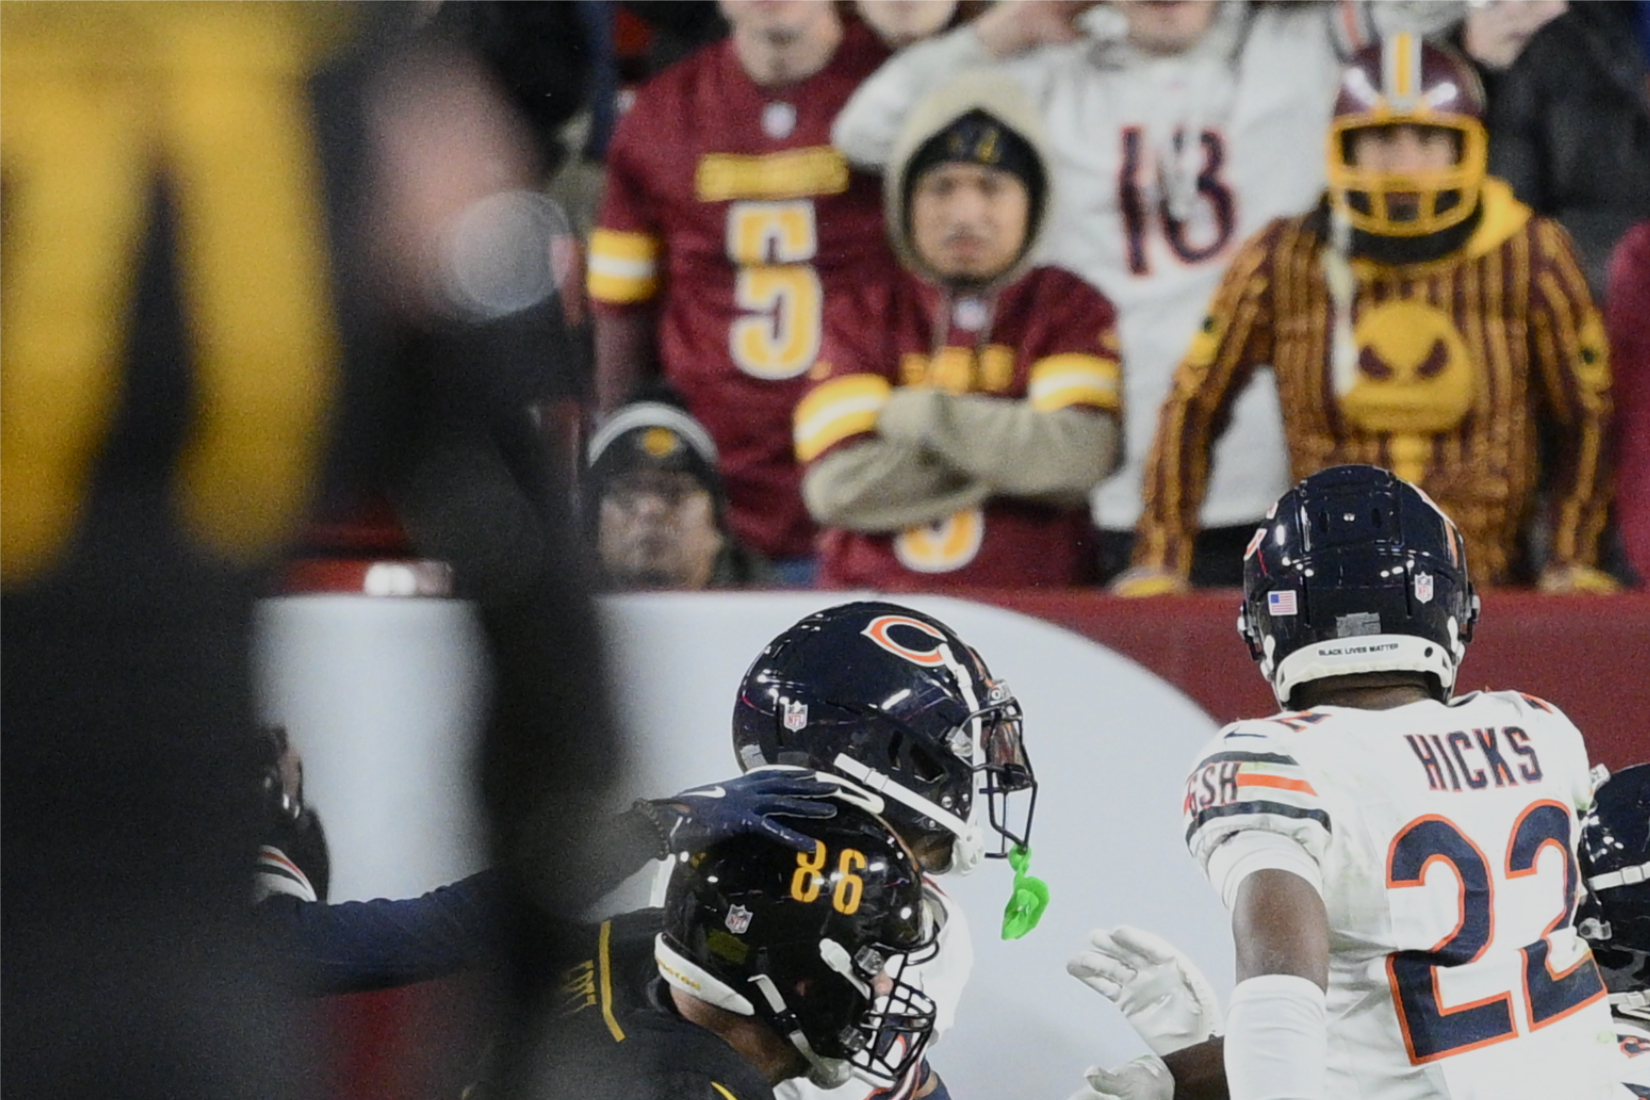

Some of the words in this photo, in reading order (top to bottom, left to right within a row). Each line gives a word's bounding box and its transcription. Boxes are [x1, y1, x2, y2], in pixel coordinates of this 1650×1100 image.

[1119, 124, 1237, 276] 13
[727, 199, 824, 380] 5
[1318, 648, 1342, 656] BLACK
[1345, 646, 1367, 655] LIVES
[1369, 642, 1399, 653] MATTER
[1404, 726, 1544, 792] HICKS
[791, 839, 867, 915] 86
[1386, 798, 1609, 1067] 22
